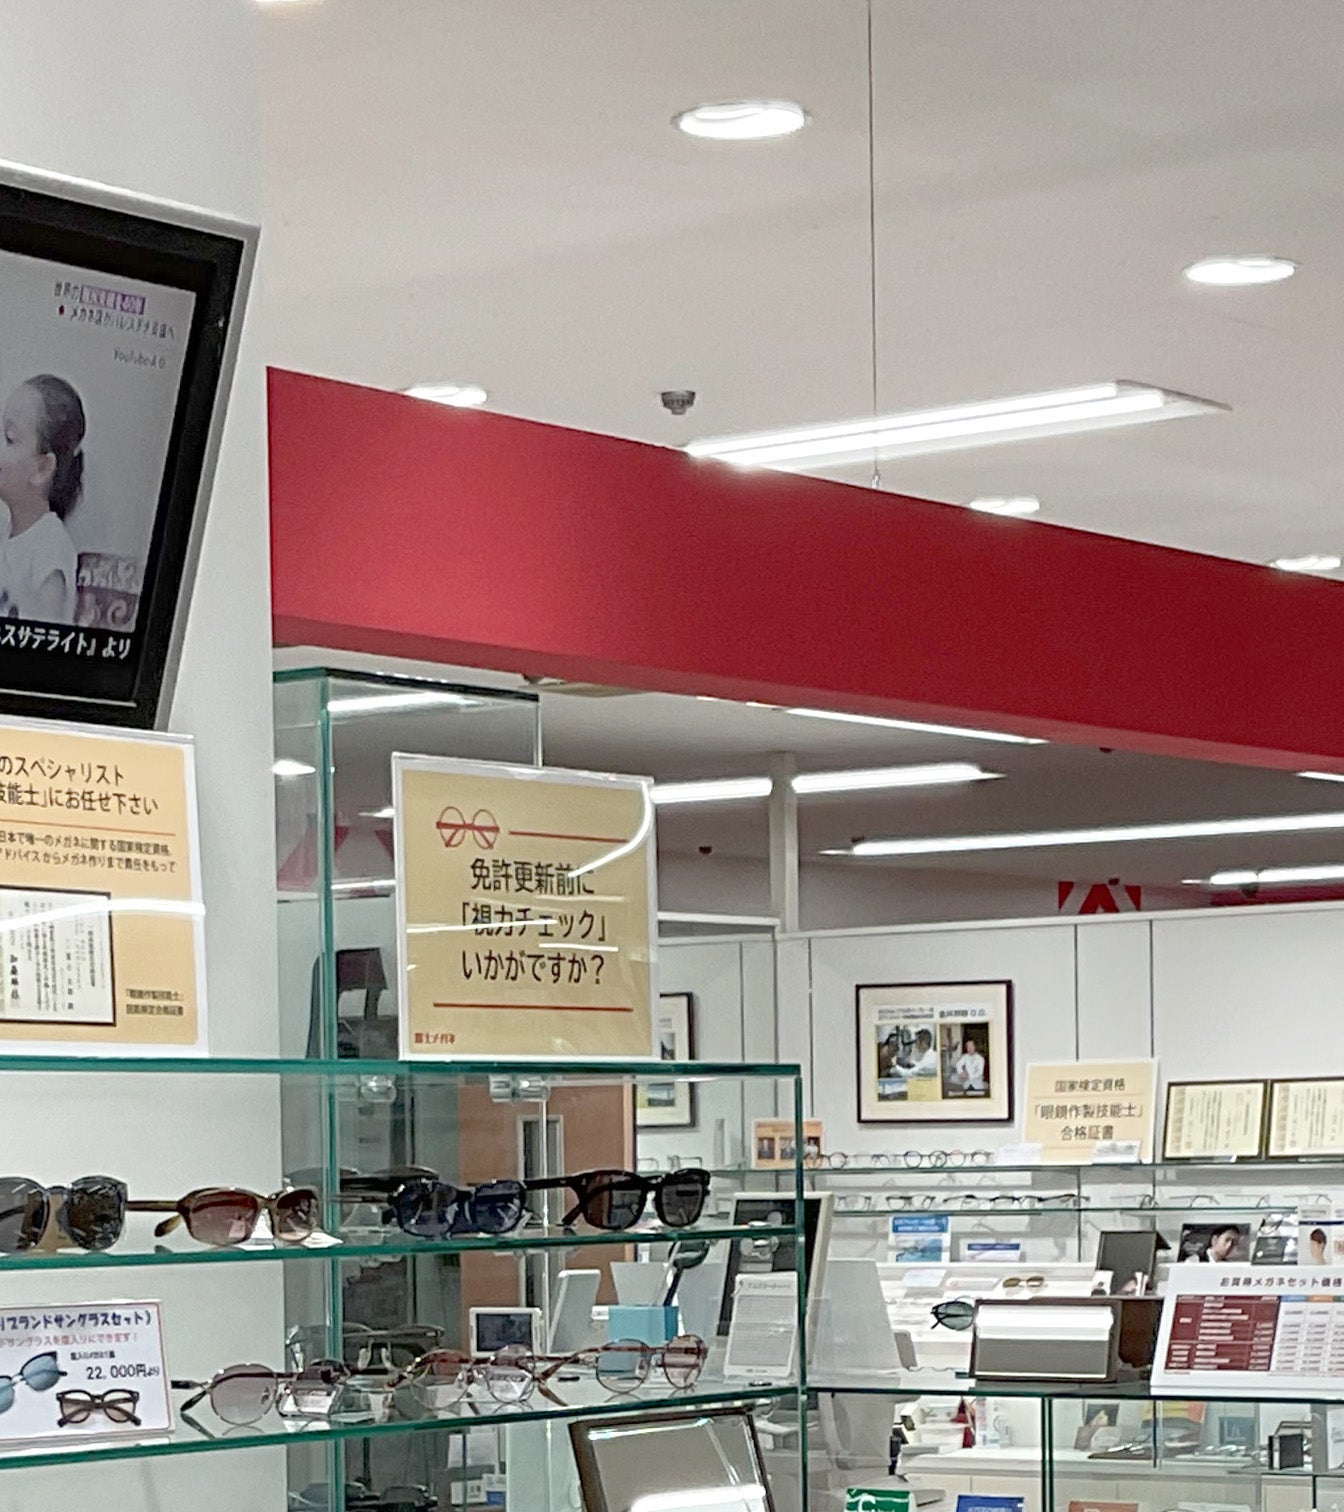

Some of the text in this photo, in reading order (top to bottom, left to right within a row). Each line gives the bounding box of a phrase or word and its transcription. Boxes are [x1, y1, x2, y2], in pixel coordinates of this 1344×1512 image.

[471, 858, 595, 895] 免許更新前に
[462, 902, 605, 941] 「視力チェック」
[462, 950, 605, 985] いかがですか？
